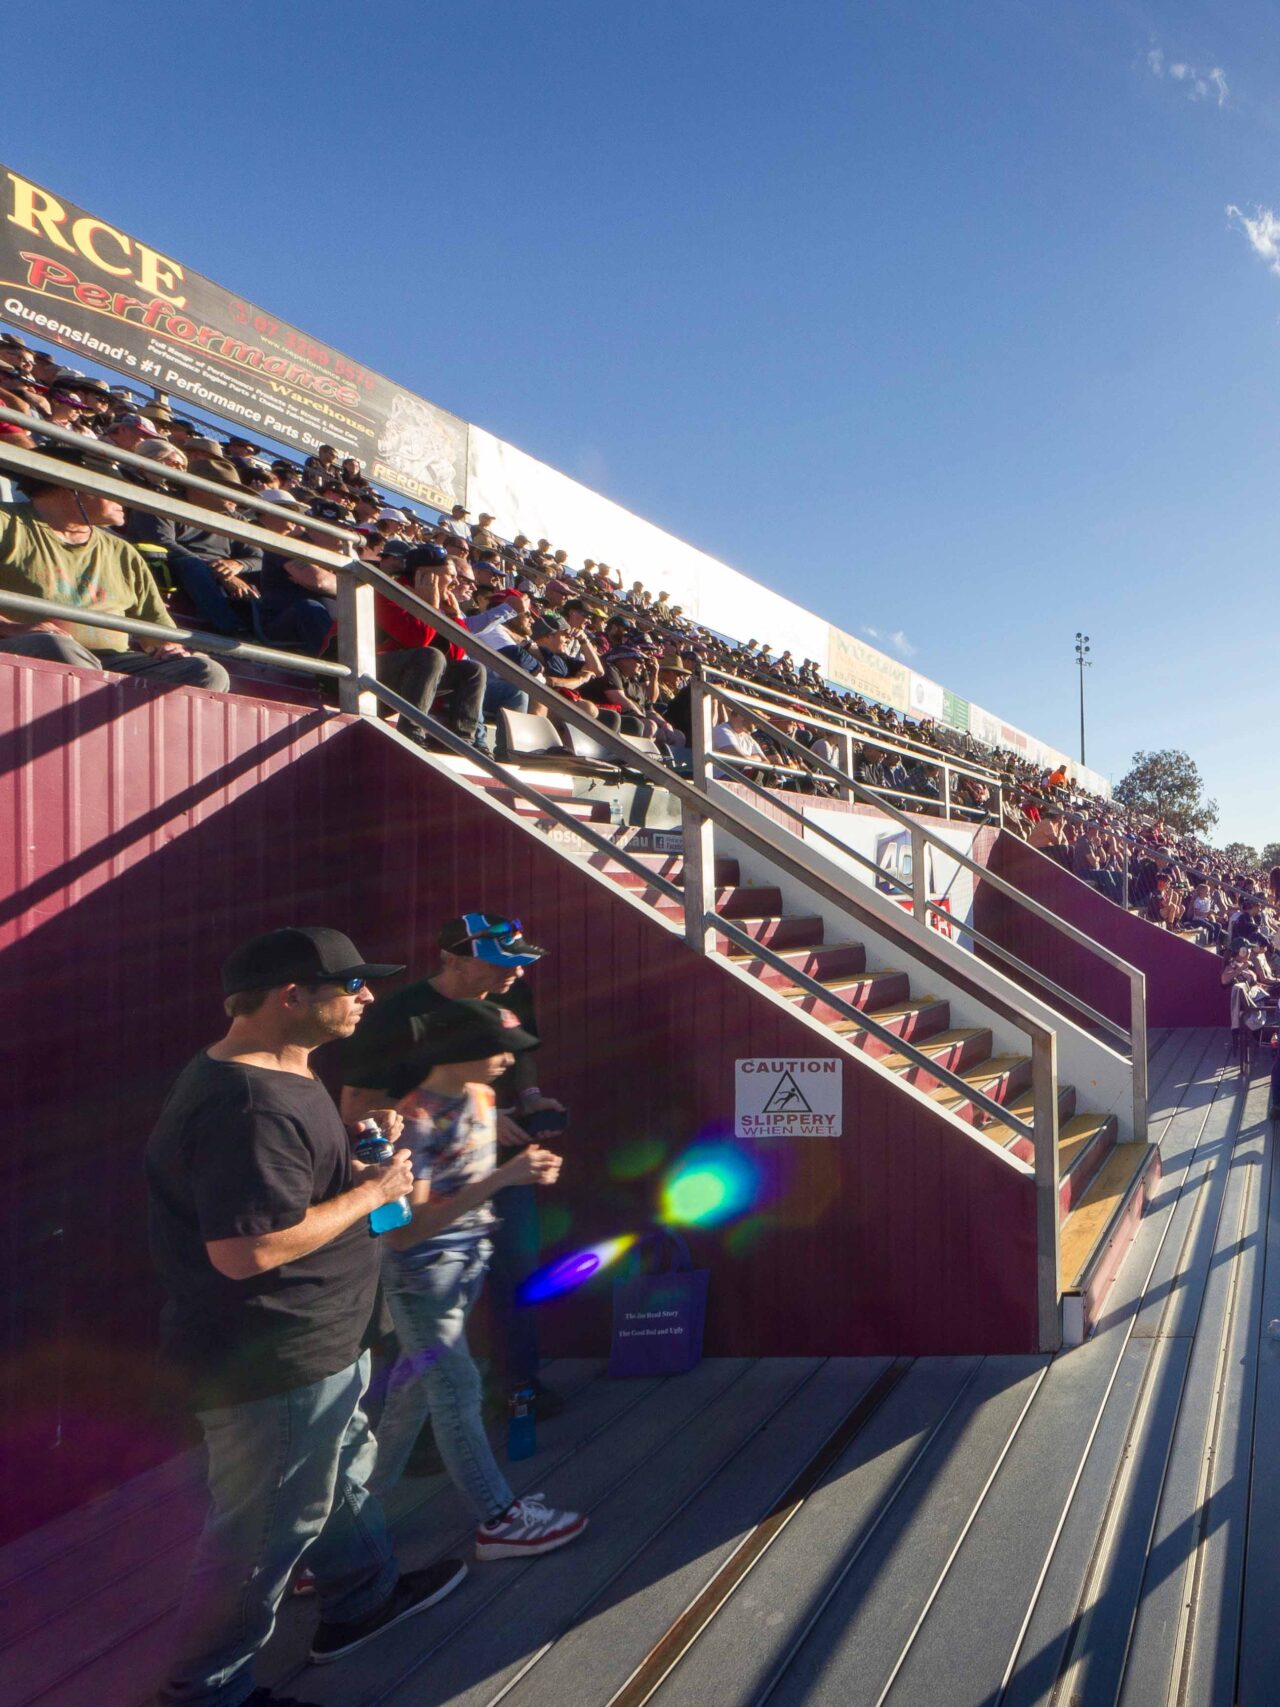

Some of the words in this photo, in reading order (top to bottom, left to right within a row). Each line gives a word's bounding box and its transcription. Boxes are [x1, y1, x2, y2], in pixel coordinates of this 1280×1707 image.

[7, 173, 189, 312] RCE
[20, 251, 361, 407] Performance
[4, 298, 137, 367] Queensland's
[140, 357, 162, 377] #1
[165, 370, 262, 422] Performance
[263, 414, 299, 439] Parts
[269, 381, 375, 438] Warehouse
[741, 1061, 836, 1073] CAUTION
[741, 1114, 836, 1126] SLIPPERY
[742, 1126, 793, 1135] WHEN
[800, 1126, 834, 1135] WET
